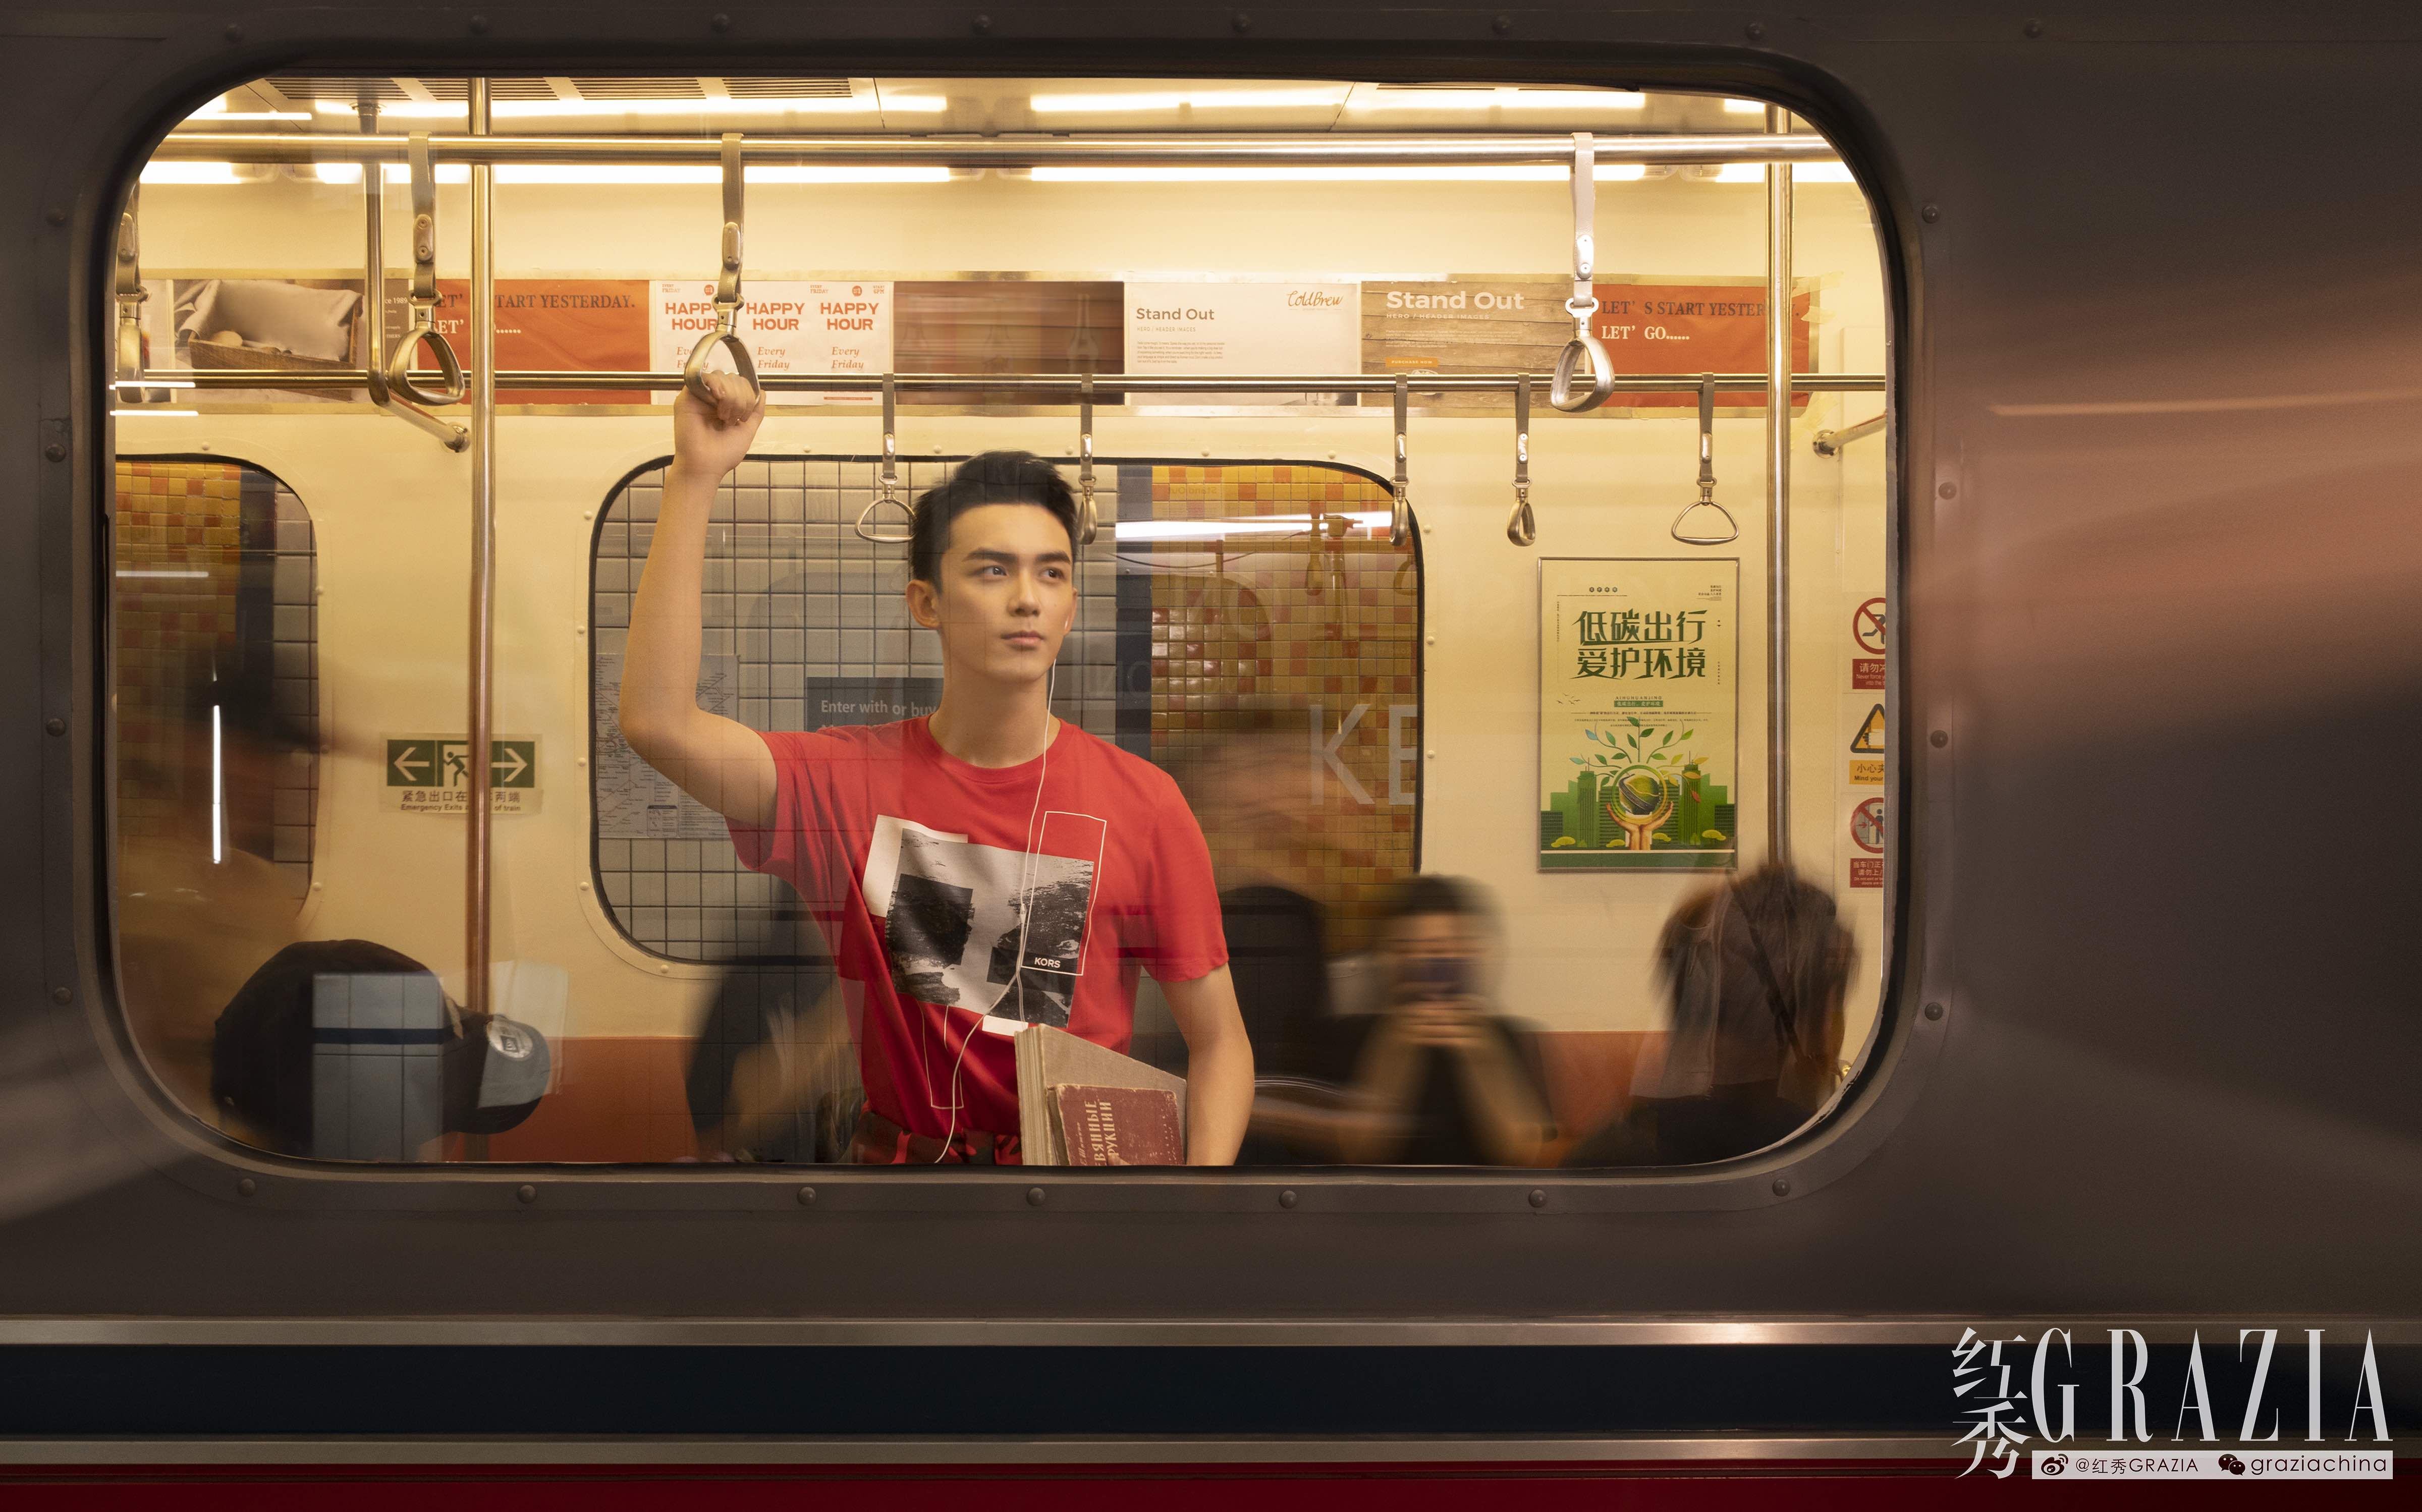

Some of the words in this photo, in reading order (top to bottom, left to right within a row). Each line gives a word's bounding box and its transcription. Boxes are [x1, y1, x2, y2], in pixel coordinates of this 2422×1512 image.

[435, 294, 463, 308] ET'
[494, 295, 536, 308] TART
[540, 295, 636, 308] YESTERDAY.
[1386, 291, 1466, 310] Stand
[1474, 292, 1524, 310] Out
[665, 302, 712, 314] HAPP
[746, 302, 805, 315] HAPPY
[820, 302, 879, 315] HAPPY
[1136, 307, 1181, 320] Stand
[1186, 308, 1215, 320] Out
[1644, 302, 1653, 315] S
[1657, 302, 1705, 316] START
[672, 318, 718, 330] HOUR
[752, 318, 799, 330] HOUR
[827, 318, 873, 330] HOUR
[757, 347, 785, 358] Every
[832, 347, 860, 358] Every
[758, 359, 790, 370] Friday
[832, 360, 864, 371] Friday
[1571, 608, 1708, 646] 低碳出行
[1569, 647, 1706, 680] 爱护环境
[821, 700, 854, 713] Enter
[859, 700, 889, 713] with
[892, 704, 906, 716] or
[402, 790, 521, 803] 紧急出口在两端
[401, 804, 442, 812] Emergency
[1034, 957, 1061, 969] KORS
